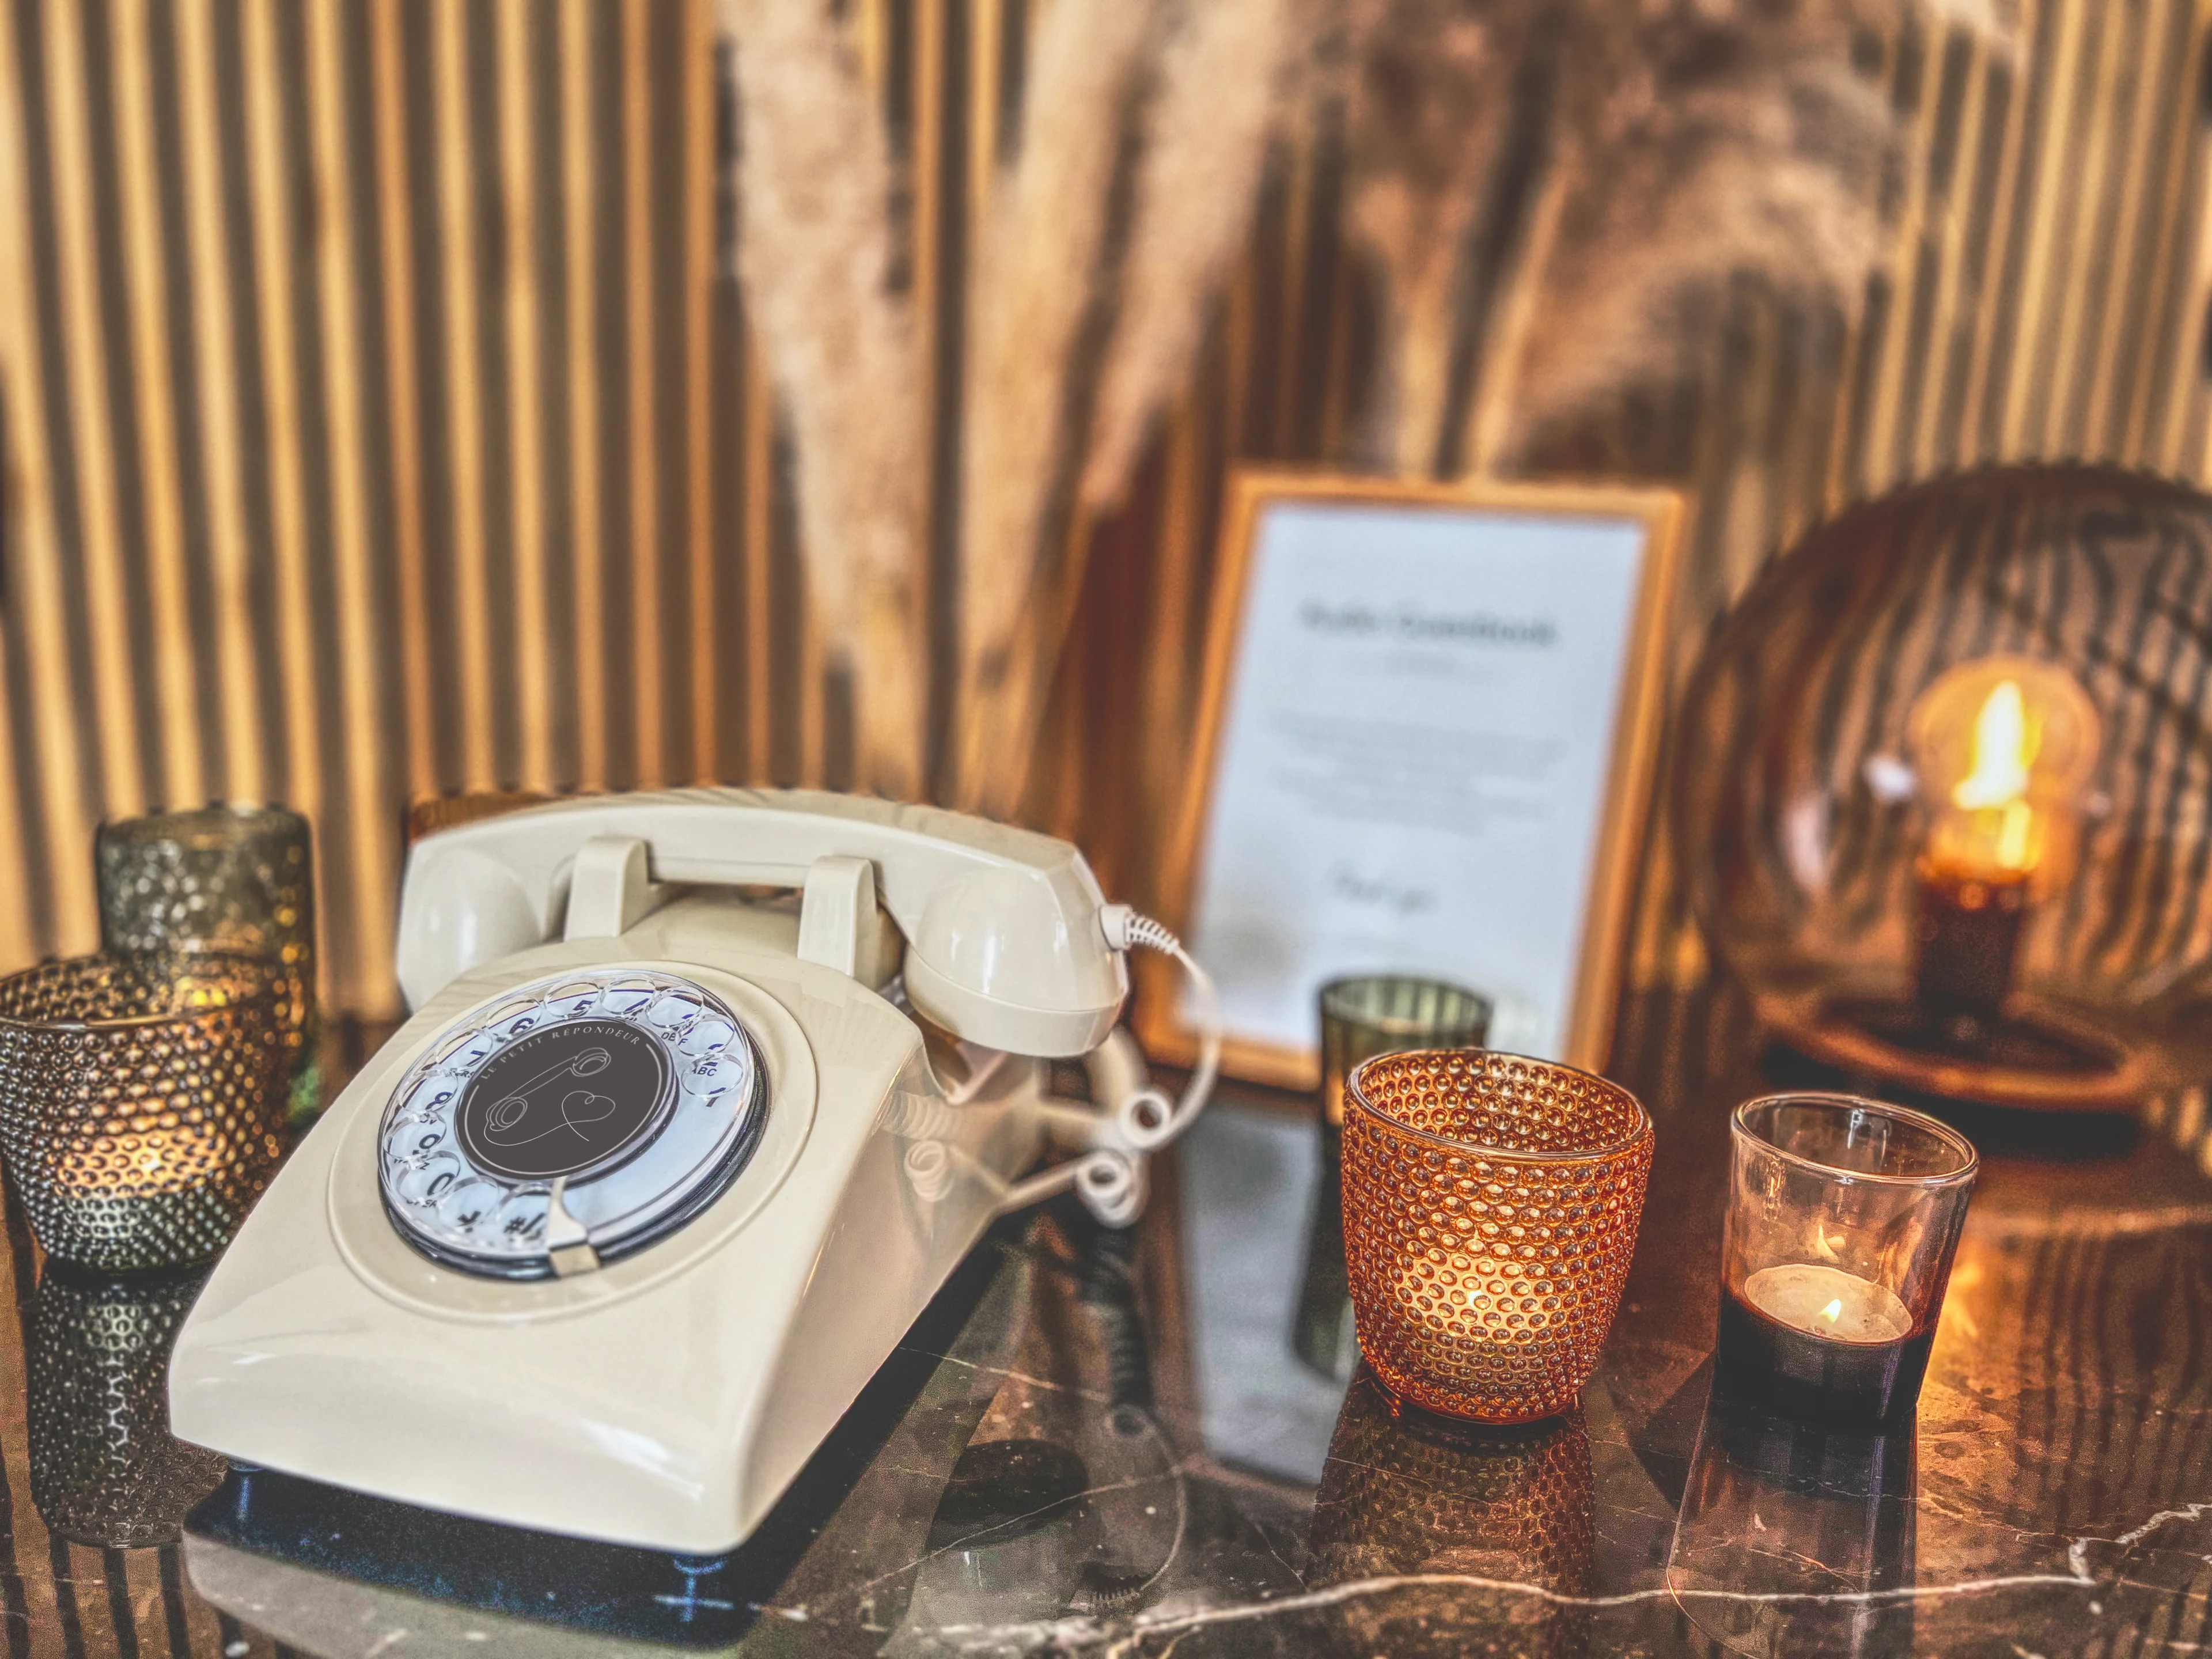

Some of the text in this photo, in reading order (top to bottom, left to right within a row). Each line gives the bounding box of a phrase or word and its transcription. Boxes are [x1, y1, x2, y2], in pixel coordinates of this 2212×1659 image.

[480, 1066, 497, 1080] LE
[499, 1036, 543, 1063] PETIT
[551, 1025, 640, 1045] RÉPONDEUR
